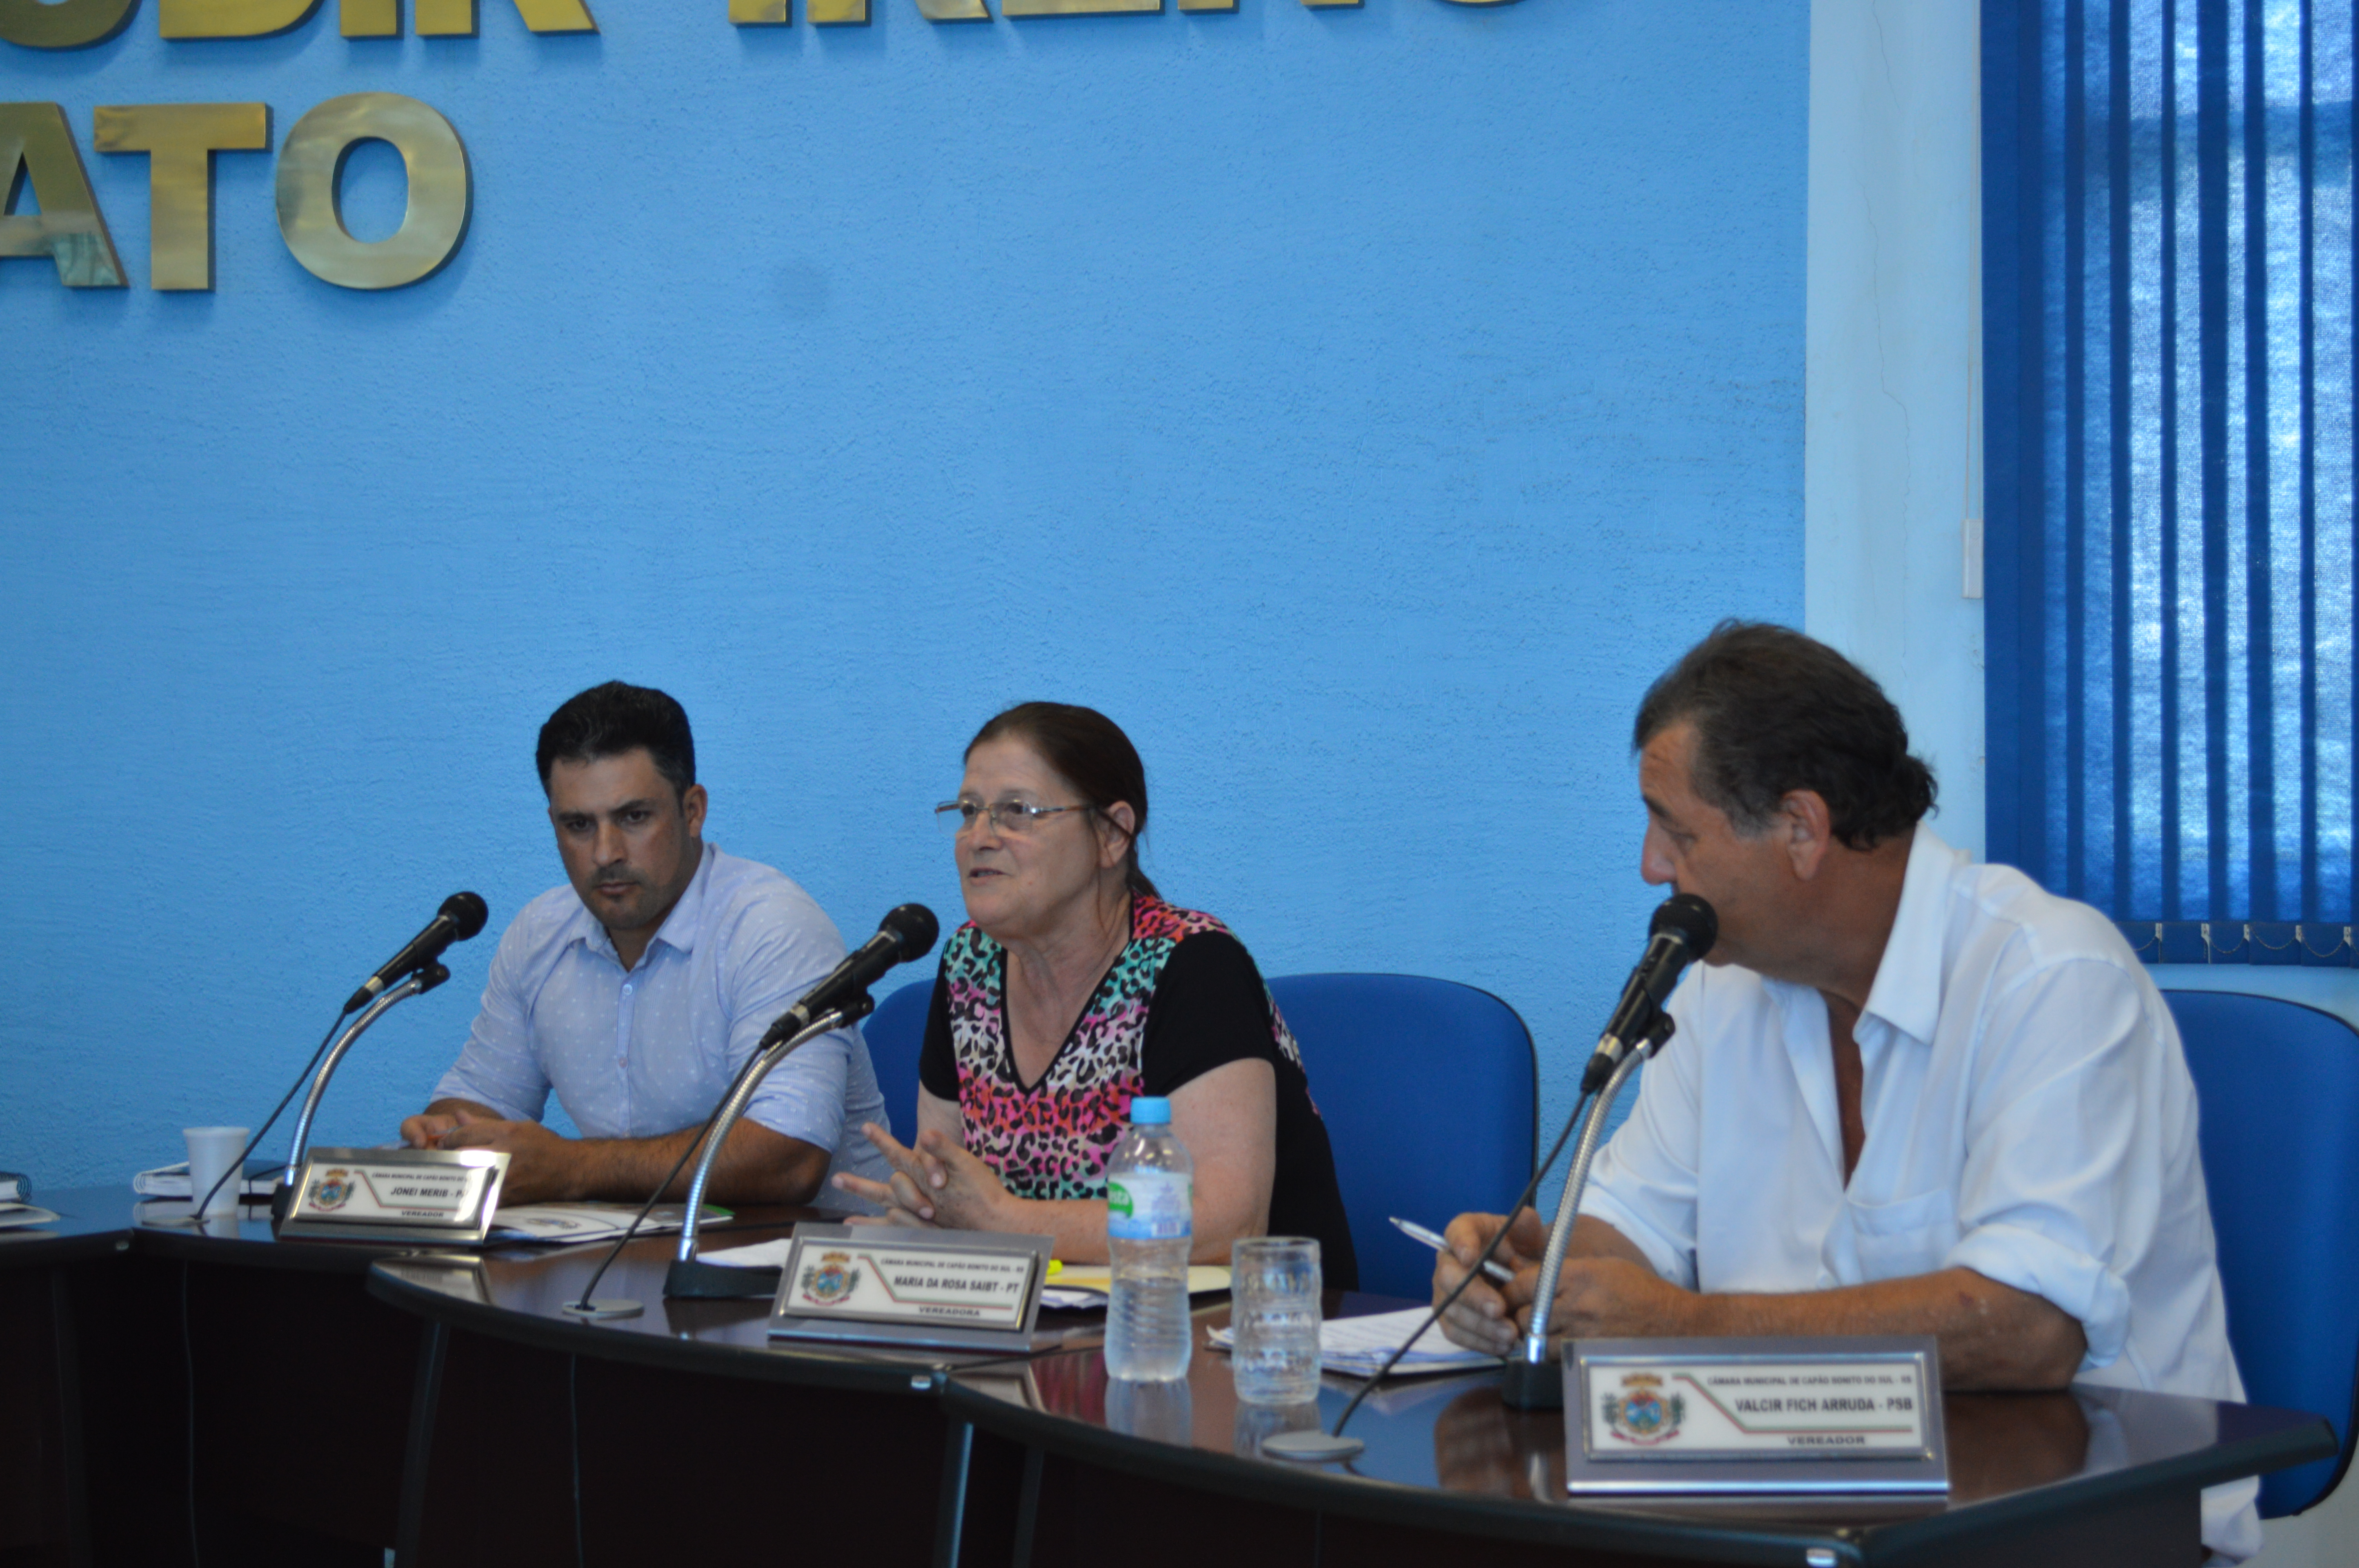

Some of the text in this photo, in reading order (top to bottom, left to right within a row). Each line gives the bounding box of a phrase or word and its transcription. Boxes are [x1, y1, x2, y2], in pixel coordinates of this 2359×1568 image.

[0, 92, 474, 290] ATO
[391, 1187, 418, 1196] JONEI
[420, 1188, 449, 1198] MERIB
[894, 1276, 923, 1287] MARIA
[926, 1277, 938, 1288] DA
[941, 1278, 966, 1289] ROSA
[970, 1279, 998, 1292] SAIBT
[1006, 1282, 1019, 1293] PT
[919, 1307, 980, 1316] VEREADORA
[1735, 1398, 1782, 1411] VALCIR
[1786, 1398, 1817, 1411] FICH
[1822, 1397, 1875, 1411] ARRUDA
[1887, 1397, 1912, 1410] PSB
[1787, 1436, 1865, 1445] VEREADOR
